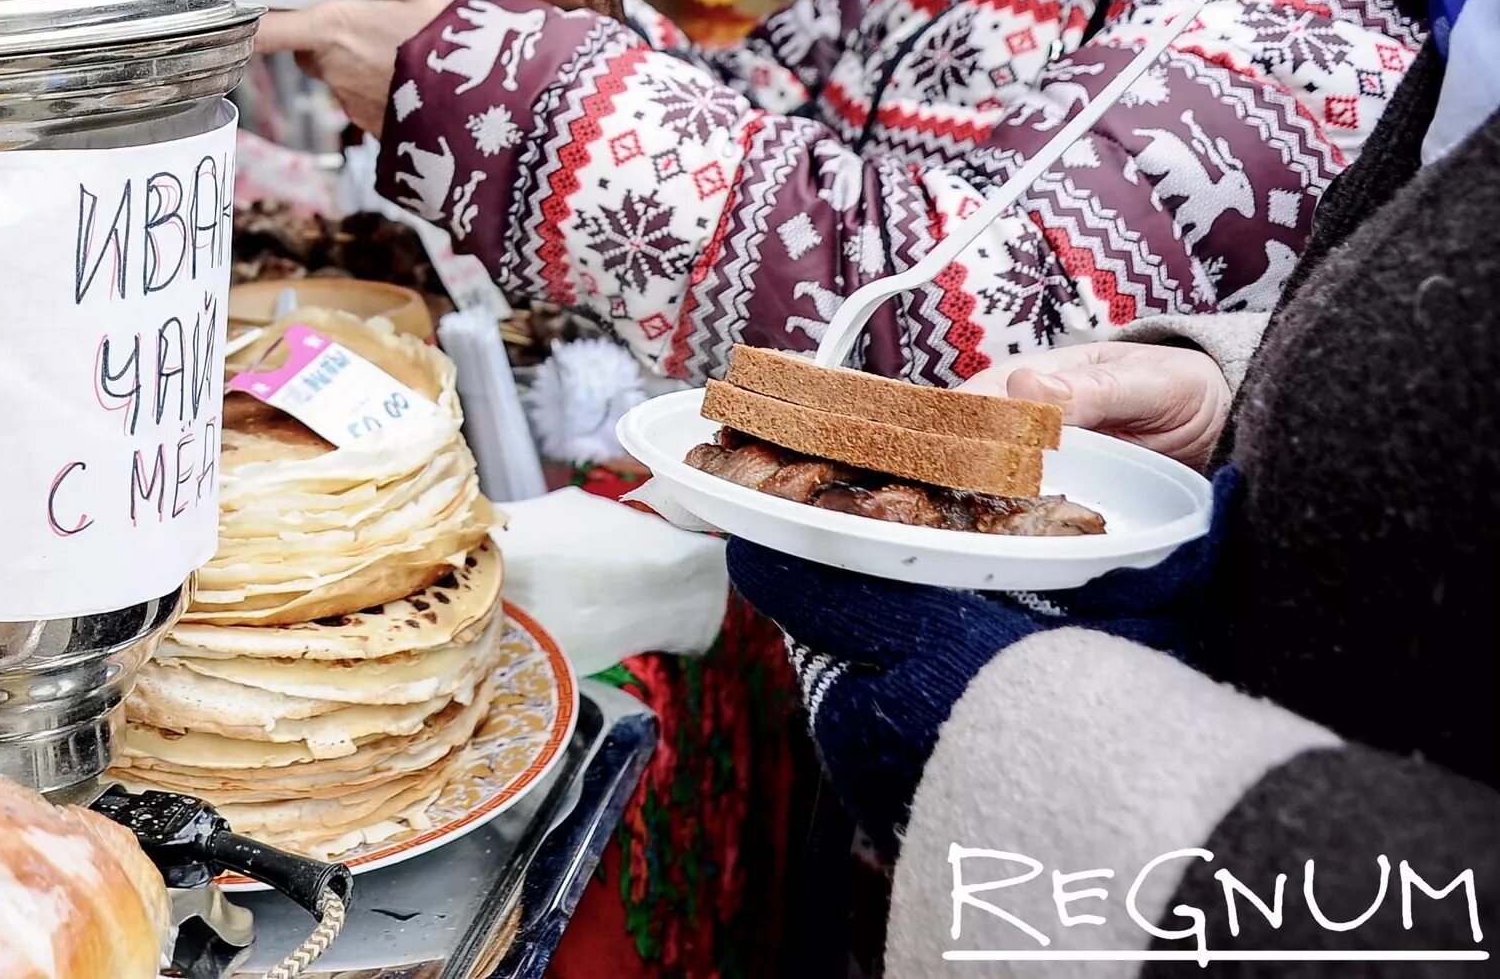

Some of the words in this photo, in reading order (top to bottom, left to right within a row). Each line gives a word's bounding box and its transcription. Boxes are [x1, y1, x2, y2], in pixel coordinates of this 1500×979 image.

[75, 152, 234, 304] ИВАН
[95, 291, 218, 435] ЧАЙ
[47, 460, 94, 536] С
